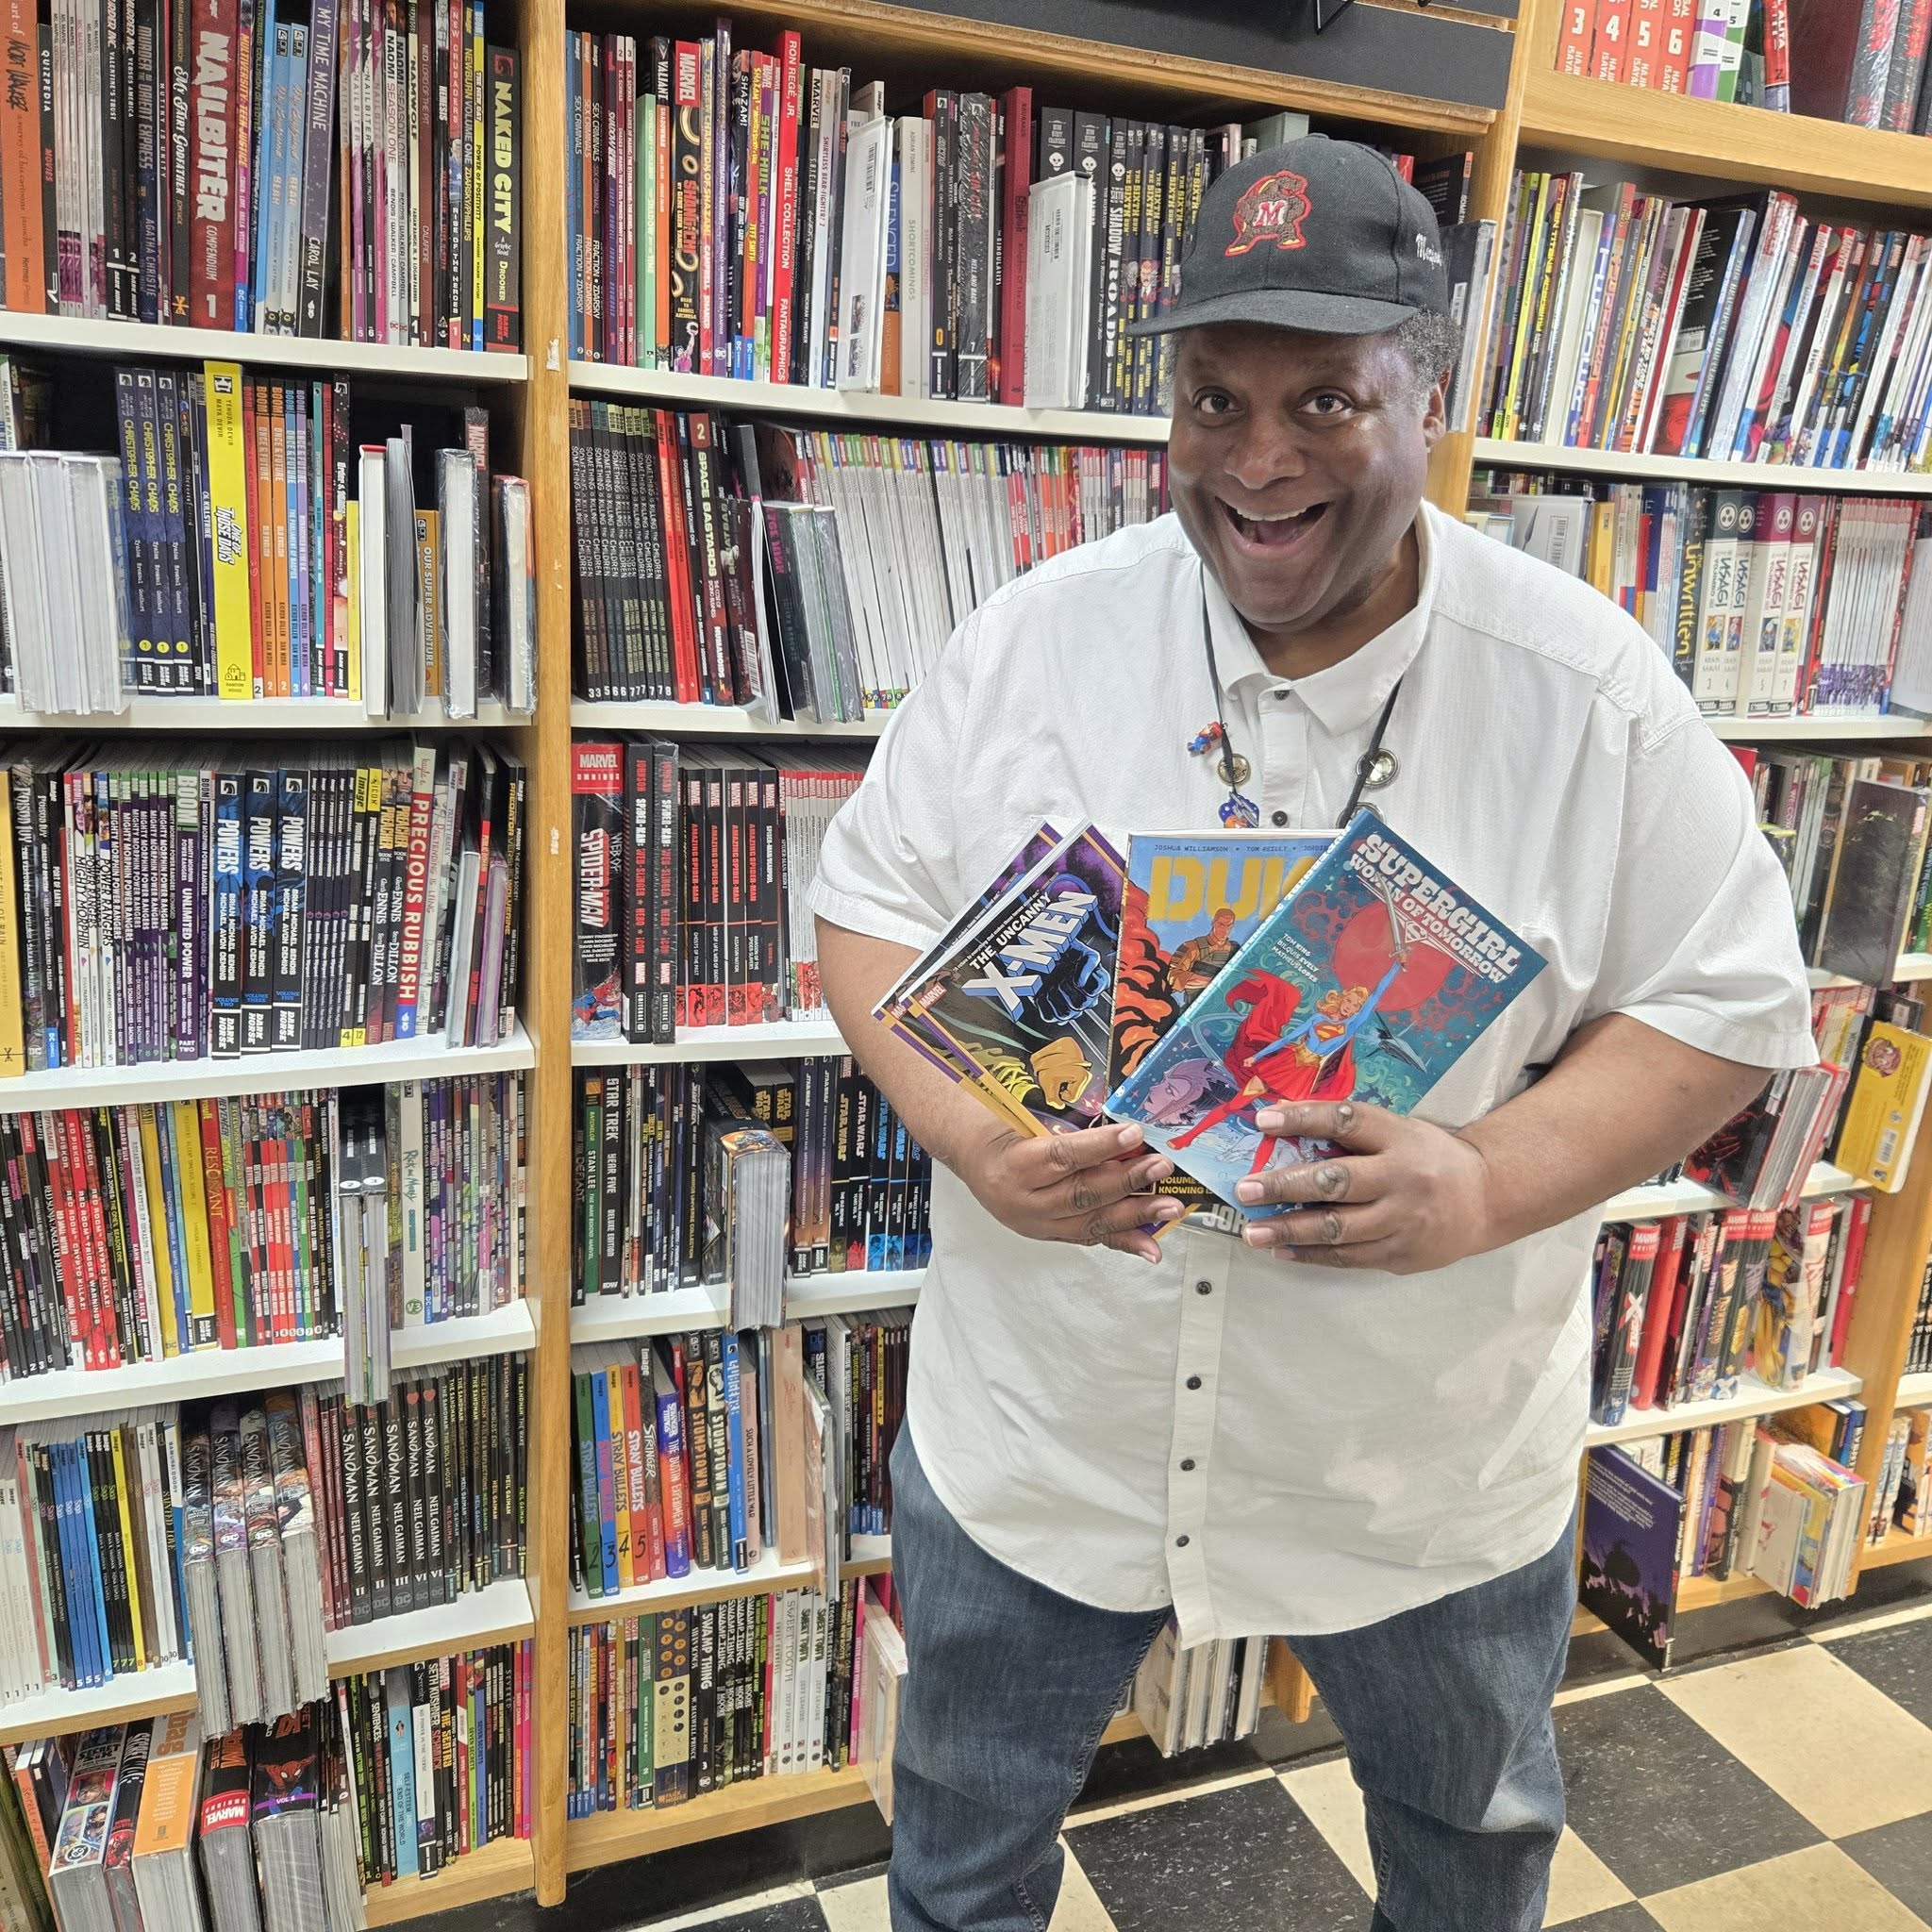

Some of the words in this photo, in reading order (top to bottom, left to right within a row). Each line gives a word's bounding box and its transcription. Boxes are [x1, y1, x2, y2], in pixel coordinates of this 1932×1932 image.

[317, 8, 331, 27] MY
[1572, 8, 1585, 34] 3
[1606, 14, 1620, 42] 4
[1637, 21, 1651, 47] 5
[137, 25, 151, 71] MURDER
[315, 33, 329, 64] TIME
[787, 40, 797, 65] RON
[1669, 28, 1682, 55] 6
[42, 50, 51, 112] QUIZPEDIA
[464, 48, 473, 99] NEWBURN
[657, 60, 669, 100] VALIANT
[678, 52, 696, 102] MARVEL
[138, 84, 152, 122] ORIENT
[312, 71, 328, 131] MACHINE
[439, 86, 447, 121] NEMESIS
[575, 95, 583, 112] SEX
[591, 102, 600, 119] SEX
[786, 102, 795, 118] JR.
[192, 30, 232, 222] NAILBITER
[464, 100, 473, 141] VOLUME
[494, 81, 511, 169] NAKED
[575, 113, 583, 155] CRIMINALS
[139, 124, 153, 171] EXPRESS
[464, 143, 473, 164] ONE
[591, 120, 601, 162] CRIMINALS
[44, 148, 53, 183] MOVIES
[783, 167, 792, 202] SHELL
[463, 166, 472, 242] ZDARSKY/PHILLIPS
[495, 174, 511, 234] CITY
[1253, 200, 1288, 227] M
[144, 219, 155, 257] AGATHA
[780, 203, 791, 269] COLLECTION
[1108, 208, 1124, 256] SHADOW
[205, 225, 218, 282] COMPENDIUM
[308, 237, 321, 266] CAROL
[592, 240, 601, 278] FRACTION
[145, 257, 157, 298] CHRISTIE
[307, 271, 320, 291] LAY
[498, 261, 508, 301] DROOKER
[206, 295, 217, 320] 1
[592, 285, 601, 319] ZDARSKY
[1106, 259, 1120, 358] ROADS
[777, 298, 789, 381] FANTAGRAPHICS
[163, 423, 177, 480] CHRISTOPHER
[698, 451, 710, 498] SPACE
[167, 482, 179, 514] CHAOS
[215, 507, 235, 537] THOSE
[232, 524, 242, 541] ONE
[702, 502, 717, 577] BASTARDS
[217, 536, 235, 566] DAYS
[232, 541, 242, 556] OF
[424, 546, 433, 569] OUR
[424, 570, 434, 604] SUPER
[1715, 558, 1733, 608] USAGI
[1770, 559, 1787, 610] USAGI
[1792, 560, 1809, 611] USAGI
[425, 606, 435, 668] ADVENTURE
[713, 626, 725, 678] HUMANOIDS
[394, 805, 409, 848] PREACHER
[216, 819, 240, 874] POWERS
[408, 799, 429, 903] PRECIOUS
[580, 829, 605, 927] SPIDER-MAN
[182, 888, 192, 940] UNLIMITED
[391, 891, 403, 922] ENNIS
[1349, 854, 1405, 902] WOMAN
[1402, 898, 1424, 917] OF
[1421, 913, 1507, 983] TOMORROW
[1357, 834, 1522, 974] SUPERGIRL
[969, 946, 997, 971] THE
[996, 891, 1053, 947] UNCANNY
[1283, 933, 1296, 946] TOM
[1294, 943, 1310, 957] KING
[182, 941, 192, 978] POWER
[387, 942, 399, 983] DILLON
[399, 911, 423, 999] RUBBISH
[960, 891, 1100, 1024] X-MEN
[1272, 946, 1299, 969] MATHEUS
[1298, 966, 1318, 983] LOPES
[1277, 940, 1300, 959] BILQUIS
[1299, 957, 1319, 973] EVELY
[606, 1078, 620, 1108] STAR
[605, 1110, 619, 1141] TREK
[588, 1150, 596, 1173] STAN
[607, 1154, 617, 1174] YEAR
[206, 1147, 223, 1219] RESONANT
[607, 1176, 616, 1194] FIVE
[1158, 1186, 1205, 1195] KNOWING
[607, 1209, 615, 1231] DELUXE
[607, 1233, 615, 1257] EDITION
[611, 1431, 625, 1466] STRAY
[628, 1430, 641, 1465] STRAY
[712, 1415, 728, 1491] STUMPTOWN
[746, 1428, 755, 1446] SUCH
[341, 1434, 360, 1504] SANDMAN
[746, 1455, 755, 1478] LOVELY
[613, 1468, 627, 1512] BULLETS
[630, 1466, 644, 1512] BULLETS
[351, 1511, 361, 1532] NEIL
[352, 1534, 364, 1574] GAIMAN
[701, 1612, 713, 1654] SWAMP
[786, 1600, 795, 1642] SWEET
[428, 1663, 440, 1686] SETH
[700, 1656, 712, 1690] THING
[784, 1644, 794, 1682] TOOTH
[429, 1687, 441, 1725] KUSHNER
[691, 1696, 697, 1705] W.
